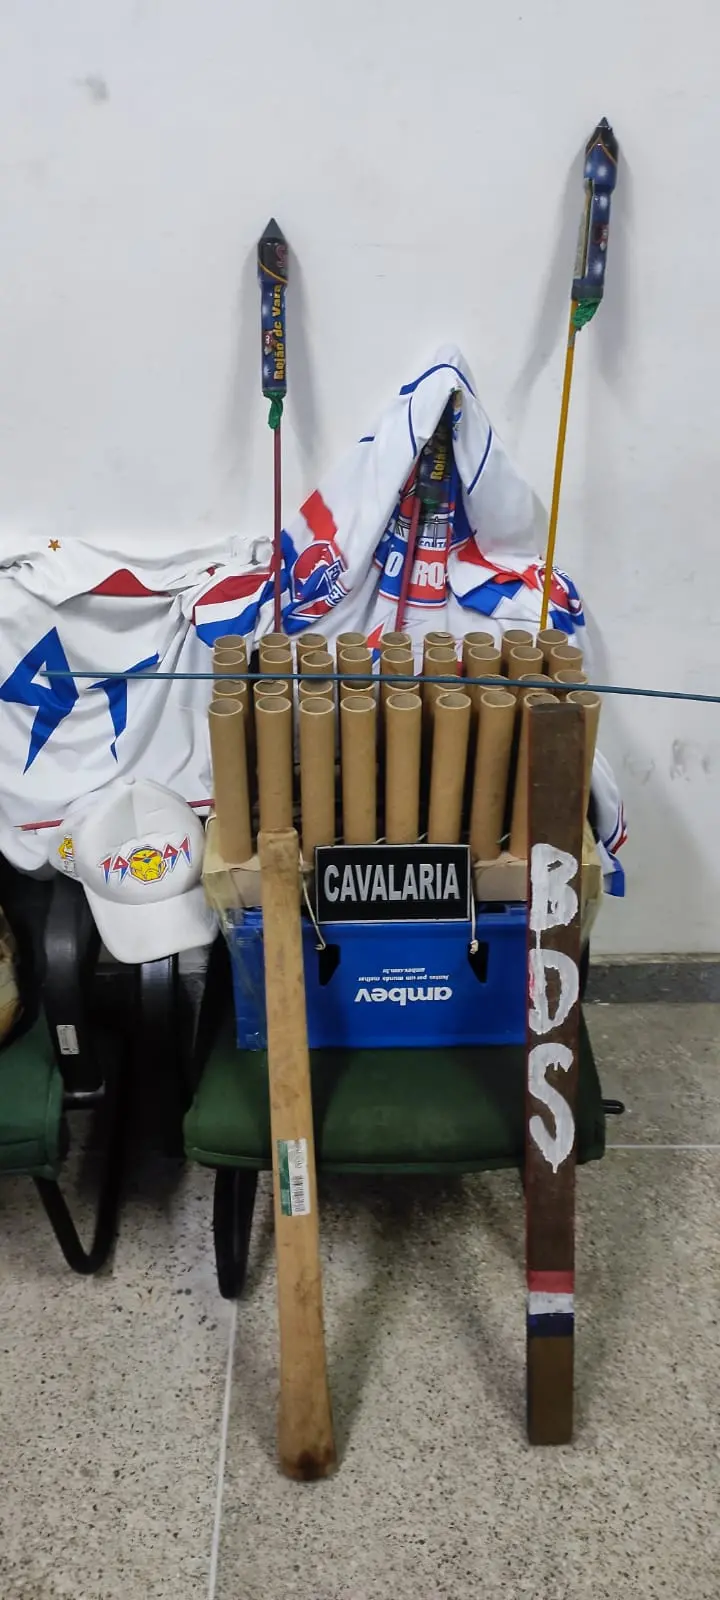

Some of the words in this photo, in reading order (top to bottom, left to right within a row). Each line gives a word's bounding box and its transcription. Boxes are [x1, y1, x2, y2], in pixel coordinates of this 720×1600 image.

[271, 284, 281, 317] Vara
[272, 321, 283, 337] de
[324, 864, 460, 901] CAVALARIA
[354, 986, 453, 1006] ambev
[528, 843, 579, 1174] BDS
